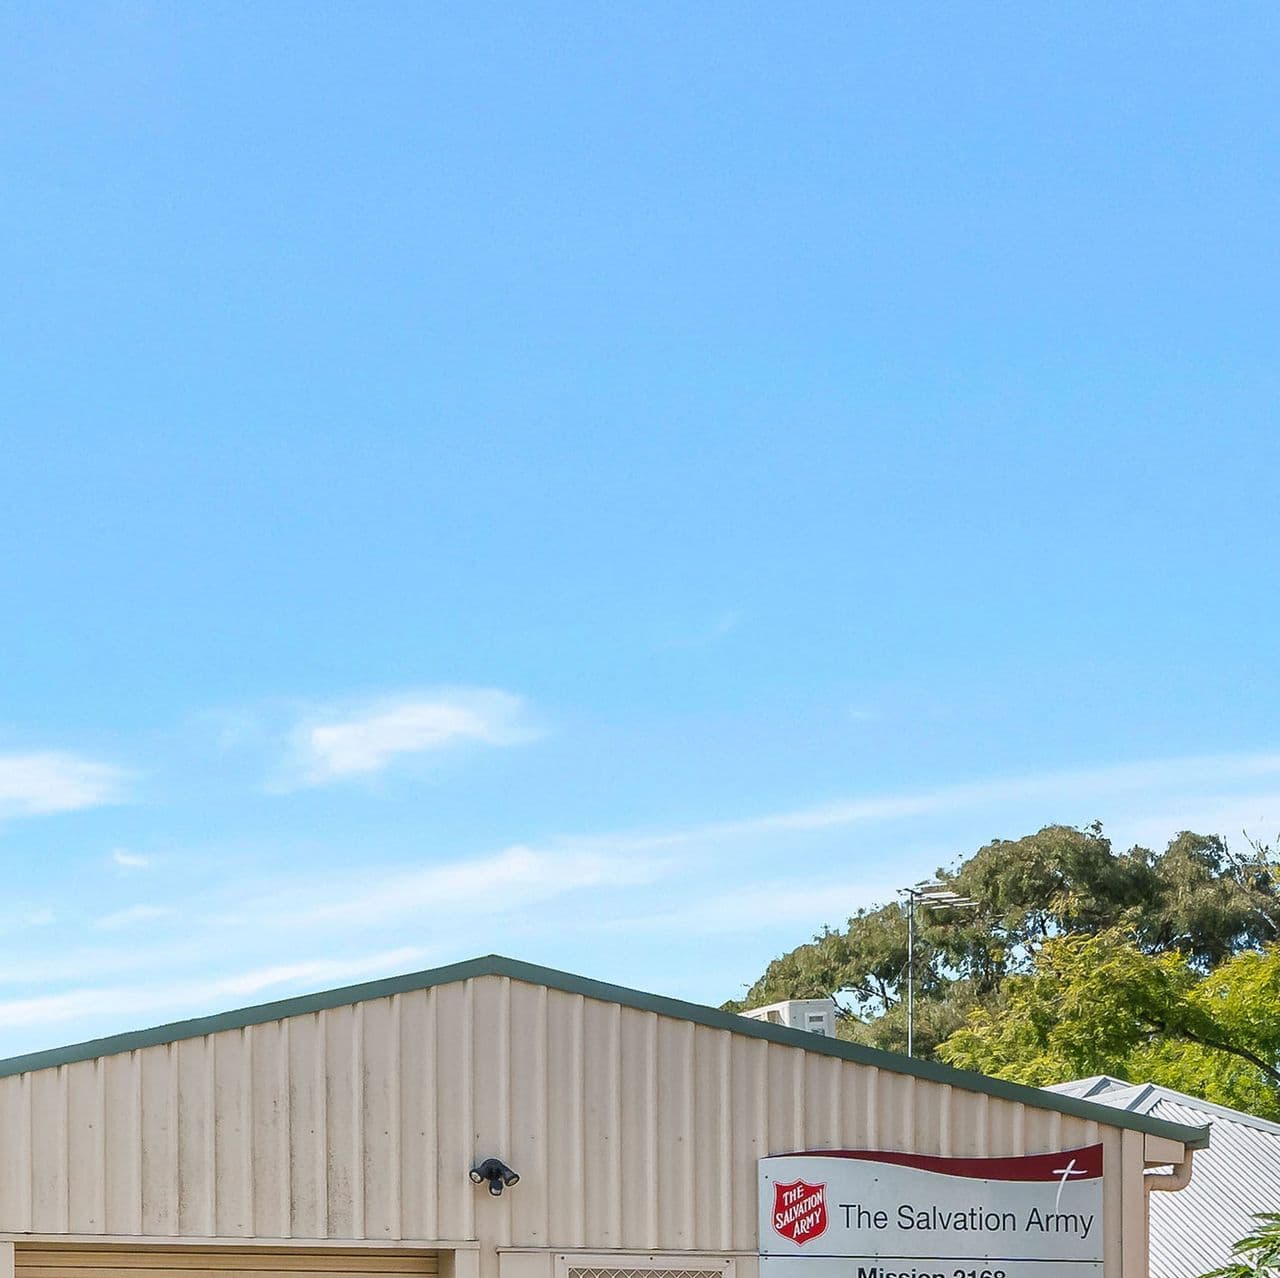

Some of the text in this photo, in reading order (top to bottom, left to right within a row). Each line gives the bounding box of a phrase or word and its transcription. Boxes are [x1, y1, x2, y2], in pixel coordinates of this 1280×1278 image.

[775, 1188, 823, 1229] SALVATION
[782, 1185, 805, 1207] THE
[792, 1207, 822, 1239] ARMY
[839, 1204, 1094, 1239] The Salvation Army
